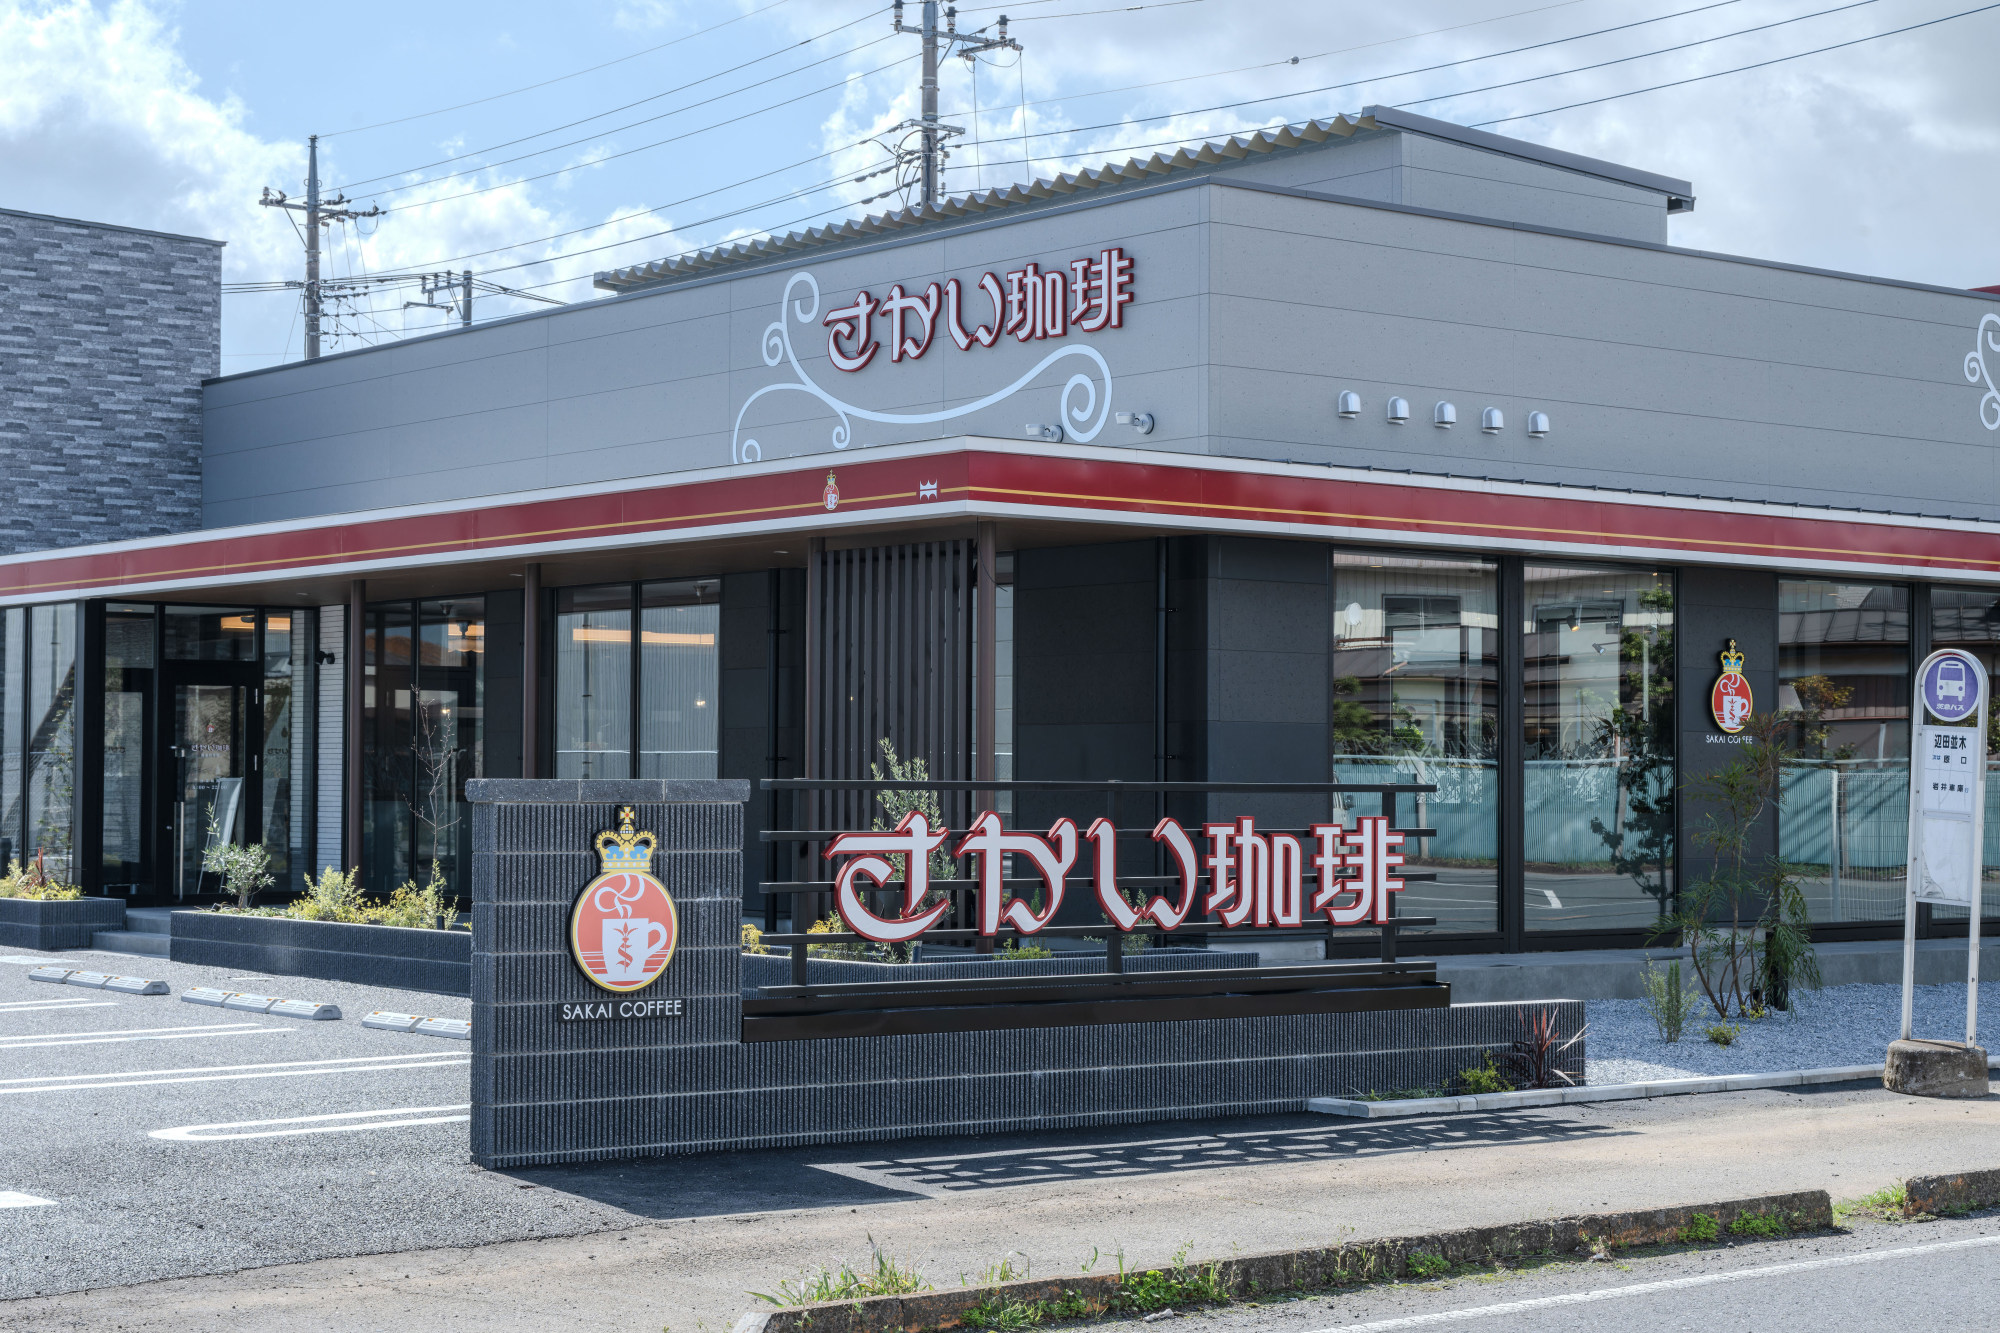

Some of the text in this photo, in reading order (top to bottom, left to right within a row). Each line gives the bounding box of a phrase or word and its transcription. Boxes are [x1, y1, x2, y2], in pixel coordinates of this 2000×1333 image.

[823, 247, 1134, 372] さかい珈琲
[1705, 734, 1726, 744] SAKAI
[1934, 733, 1967, 750] 辺田並木
[822, 810, 1405, 942] さかい珈琲
[563, 1000, 682, 1019] SAKAI COFFEE
